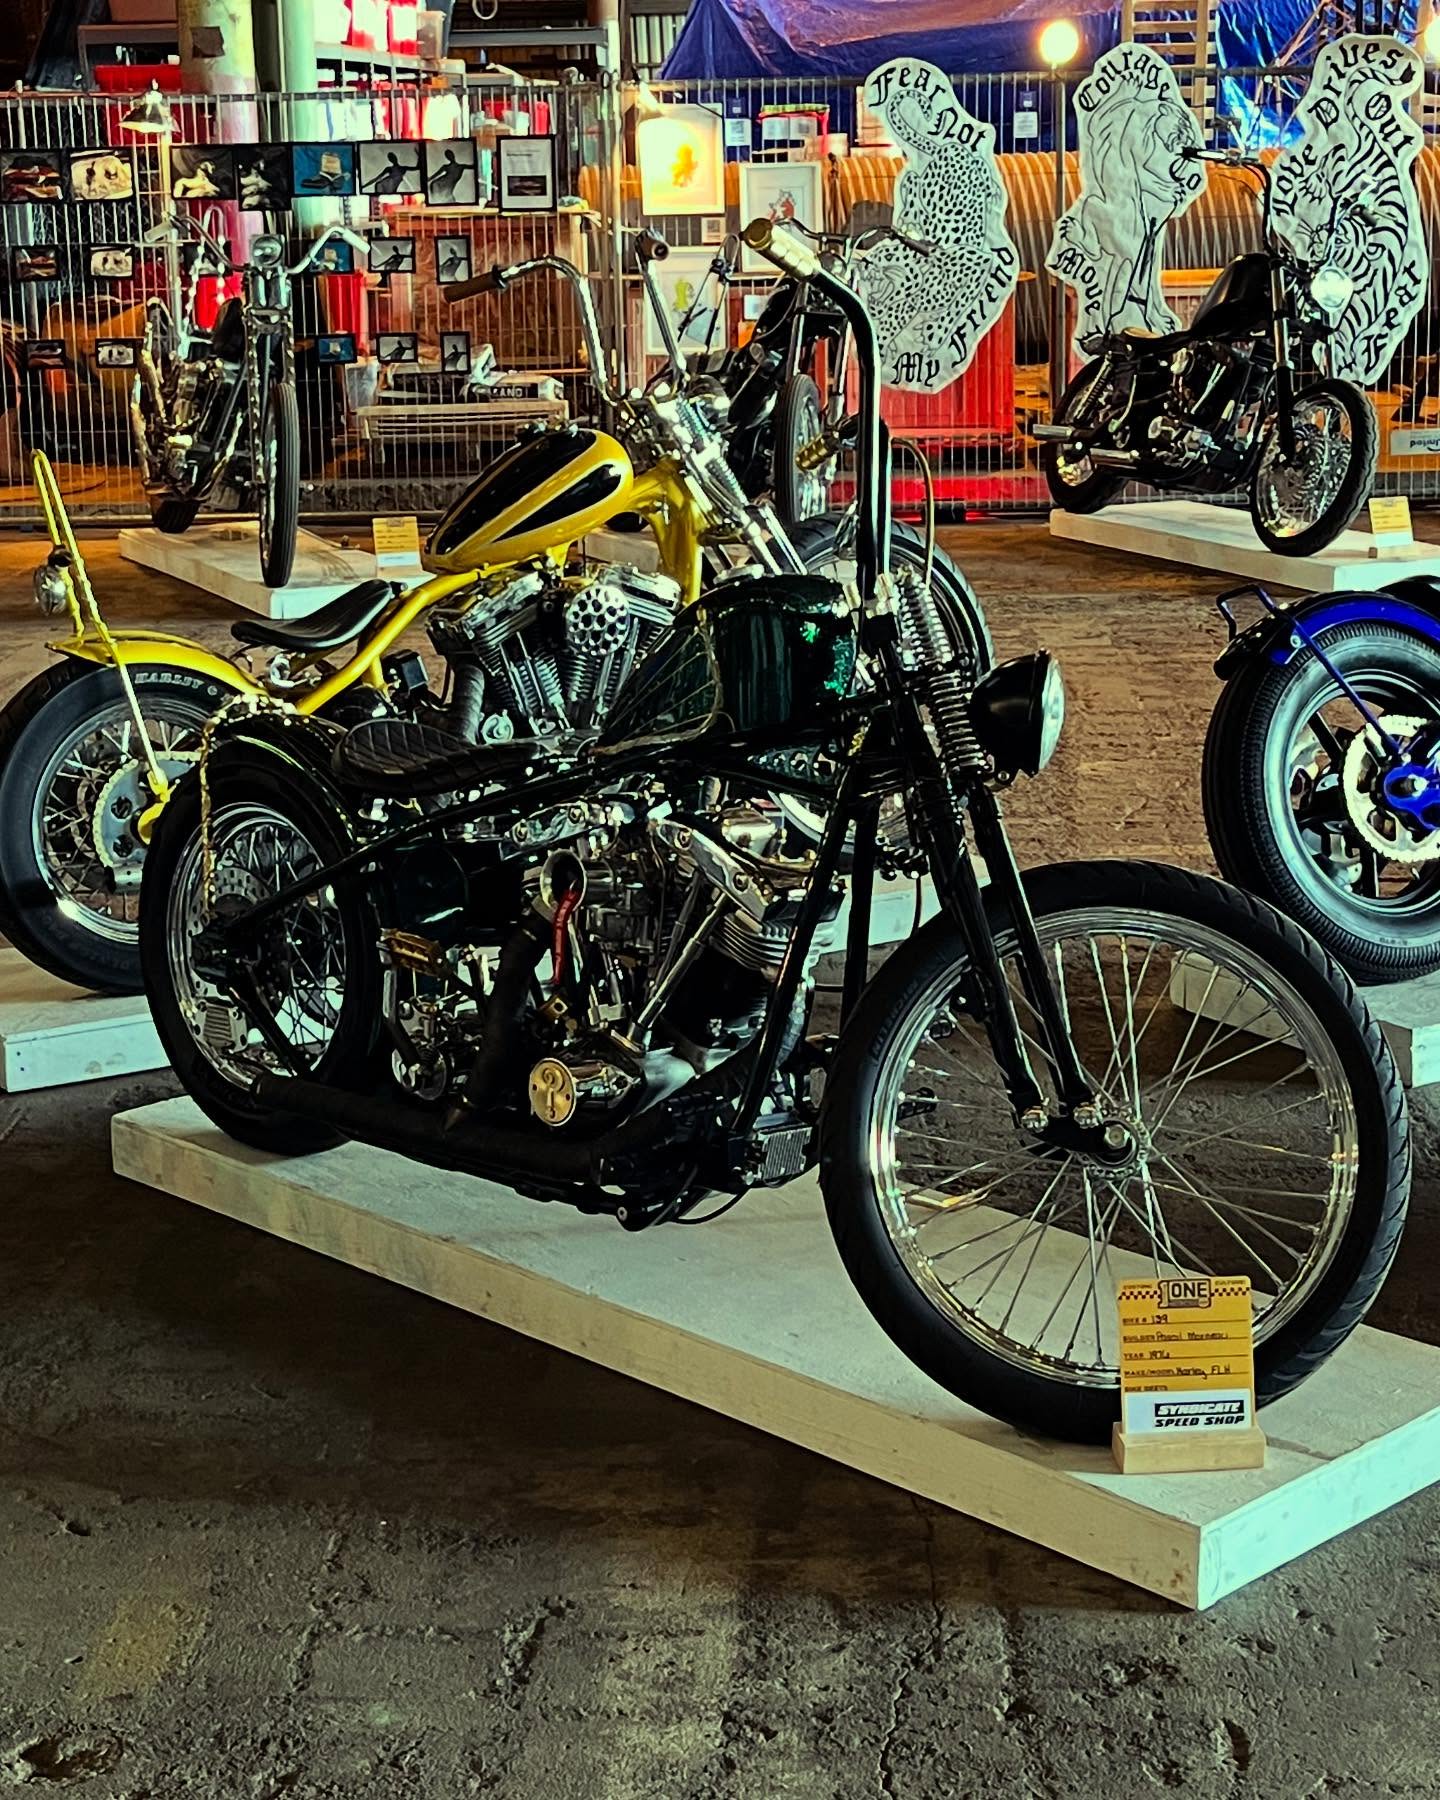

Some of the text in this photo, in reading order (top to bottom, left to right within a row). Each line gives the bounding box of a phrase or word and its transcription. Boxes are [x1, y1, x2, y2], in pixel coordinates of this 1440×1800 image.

[868, 66, 946, 107] Fear
[927, 106, 987, 152] Not
[1079, 51, 1171, 112] Courage
[1307, 43, 1404, 131] Drives
[1364, 92, 1415, 157] Out
[1271, 143, 1319, 216] Love
[948, 246, 1015, 369] Friend
[1048, 247, 1103, 316] Move
[1358, 260, 1422, 376] Fear
[890, 351, 940, 387] My
[134, 672, 205, 690] HARLEY
[1171, 1282, 1208, 1298] ONE
[1155, 1415, 1245, 1427] SPEED SHOP
[1157, 1402, 1241, 1416] SYNDICATE
